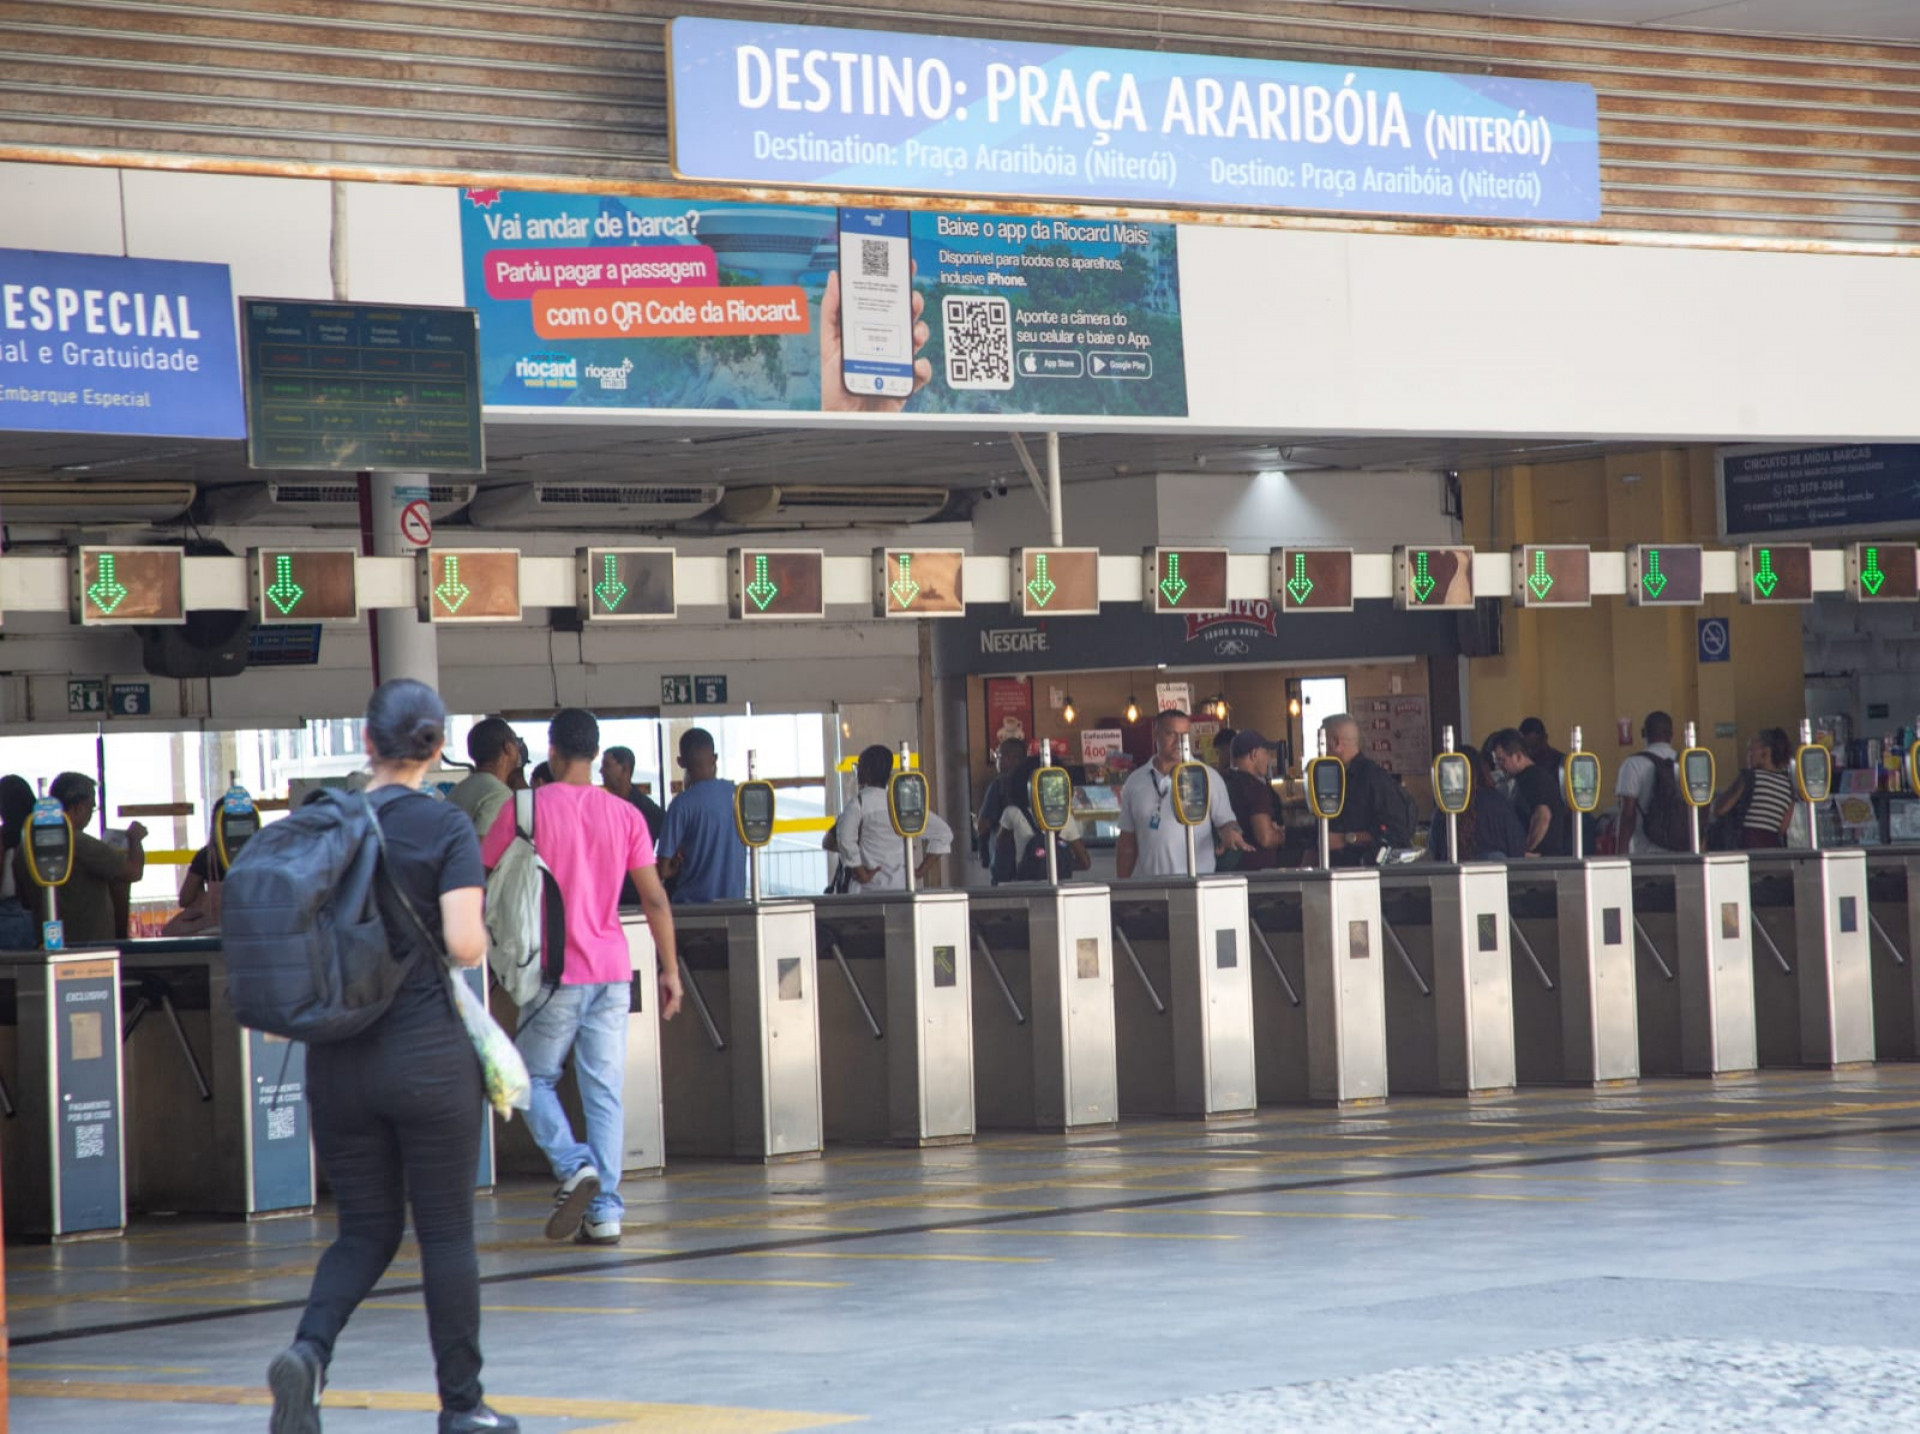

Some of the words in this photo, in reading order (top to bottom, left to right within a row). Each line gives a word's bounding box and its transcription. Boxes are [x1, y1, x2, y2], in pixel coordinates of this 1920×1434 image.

[736, 45, 968, 121] DESTINO:
[986, 63, 1147, 146] PRAÇA
[1161, 72, 1412, 150] ARARIBÓIA
[1424, 107, 1552, 166] (NITERÓI)
[753, 129, 898, 167] Destination:
[905, 139, 969, 176] Praça
[976, 143, 1077, 177] Araribóia
[1084, 147, 1177, 189] (Niterói)
[1210, 157, 1295, 188] Destino:
[1301, 162, 1357, 198] Praça
[1363, 164, 1453, 197] Araribóia
[1459, 170, 1542, 207] (Niterói)
[484, 212, 522, 240] Vai
[526, 211, 589, 240] andar
[594, 211, 623, 238] de
[626, 209, 700, 239] barca?
[937, 216, 979, 236] Baixe
[983, 223, 994, 235] o
[998, 224, 1027, 244] app
[1031, 221, 1050, 240] da
[1054, 222, 1110, 242] Riocard
[939, 250, 994, 267] Disponível
[996, 254, 1019, 268] para
[1021, 252, 1053, 268] todos
[1056, 256, 1069, 268] os
[1072, 256, 1123, 272] aparelhos,
[496, 261, 550, 283] Partiu
[554, 263, 602, 288] pagar
[606, 263, 617, 279] a
[621, 260, 706, 285] passagem
[941, 271, 985, 285] inclusive
[987, 272, 1027, 287] iPhone.
[3, 285, 200, 339] ESPECIAL
[546, 306, 590, 327] com
[594, 307, 607, 326] o
[612, 301, 642, 331] QR
[645, 299, 696, 324] Code
[700, 301, 723, 323] da
[726, 299, 801, 322] Riocard.
[1016, 309, 1058, 326] Aponte
[1060, 313, 1068, 324] a
[1070, 310, 1110, 325] câmera
[1113, 312, 1127, 326] do
[1016, 331, 1037, 342] seu
[1039, 330, 1075, 344] celular
[1077, 333, 1085, 343] e
[1087, 331, 1115, 344] baixe
[1117, 335, 1125, 344] o
[1128, 331, 1151, 349] App.
[38, 345, 53, 364] e
[62, 341, 199, 372] Gratuidade
[515, 357, 577, 378] riocard
[1044, 359, 1057, 369] App
[1109, 360, 1131, 371] Google
[1132, 361, 1146, 371] Play
[585, 363, 626, 379] riocard
[83, 388, 151, 409] Especial
[1744, 456, 1788, 471] CIRCUITO
[1790, 454, 1801, 465] DE
[1833, 446, 1872, 461] BARCAS
[124, 694, 138, 713] 6
[706, 685, 717, 702] 5
